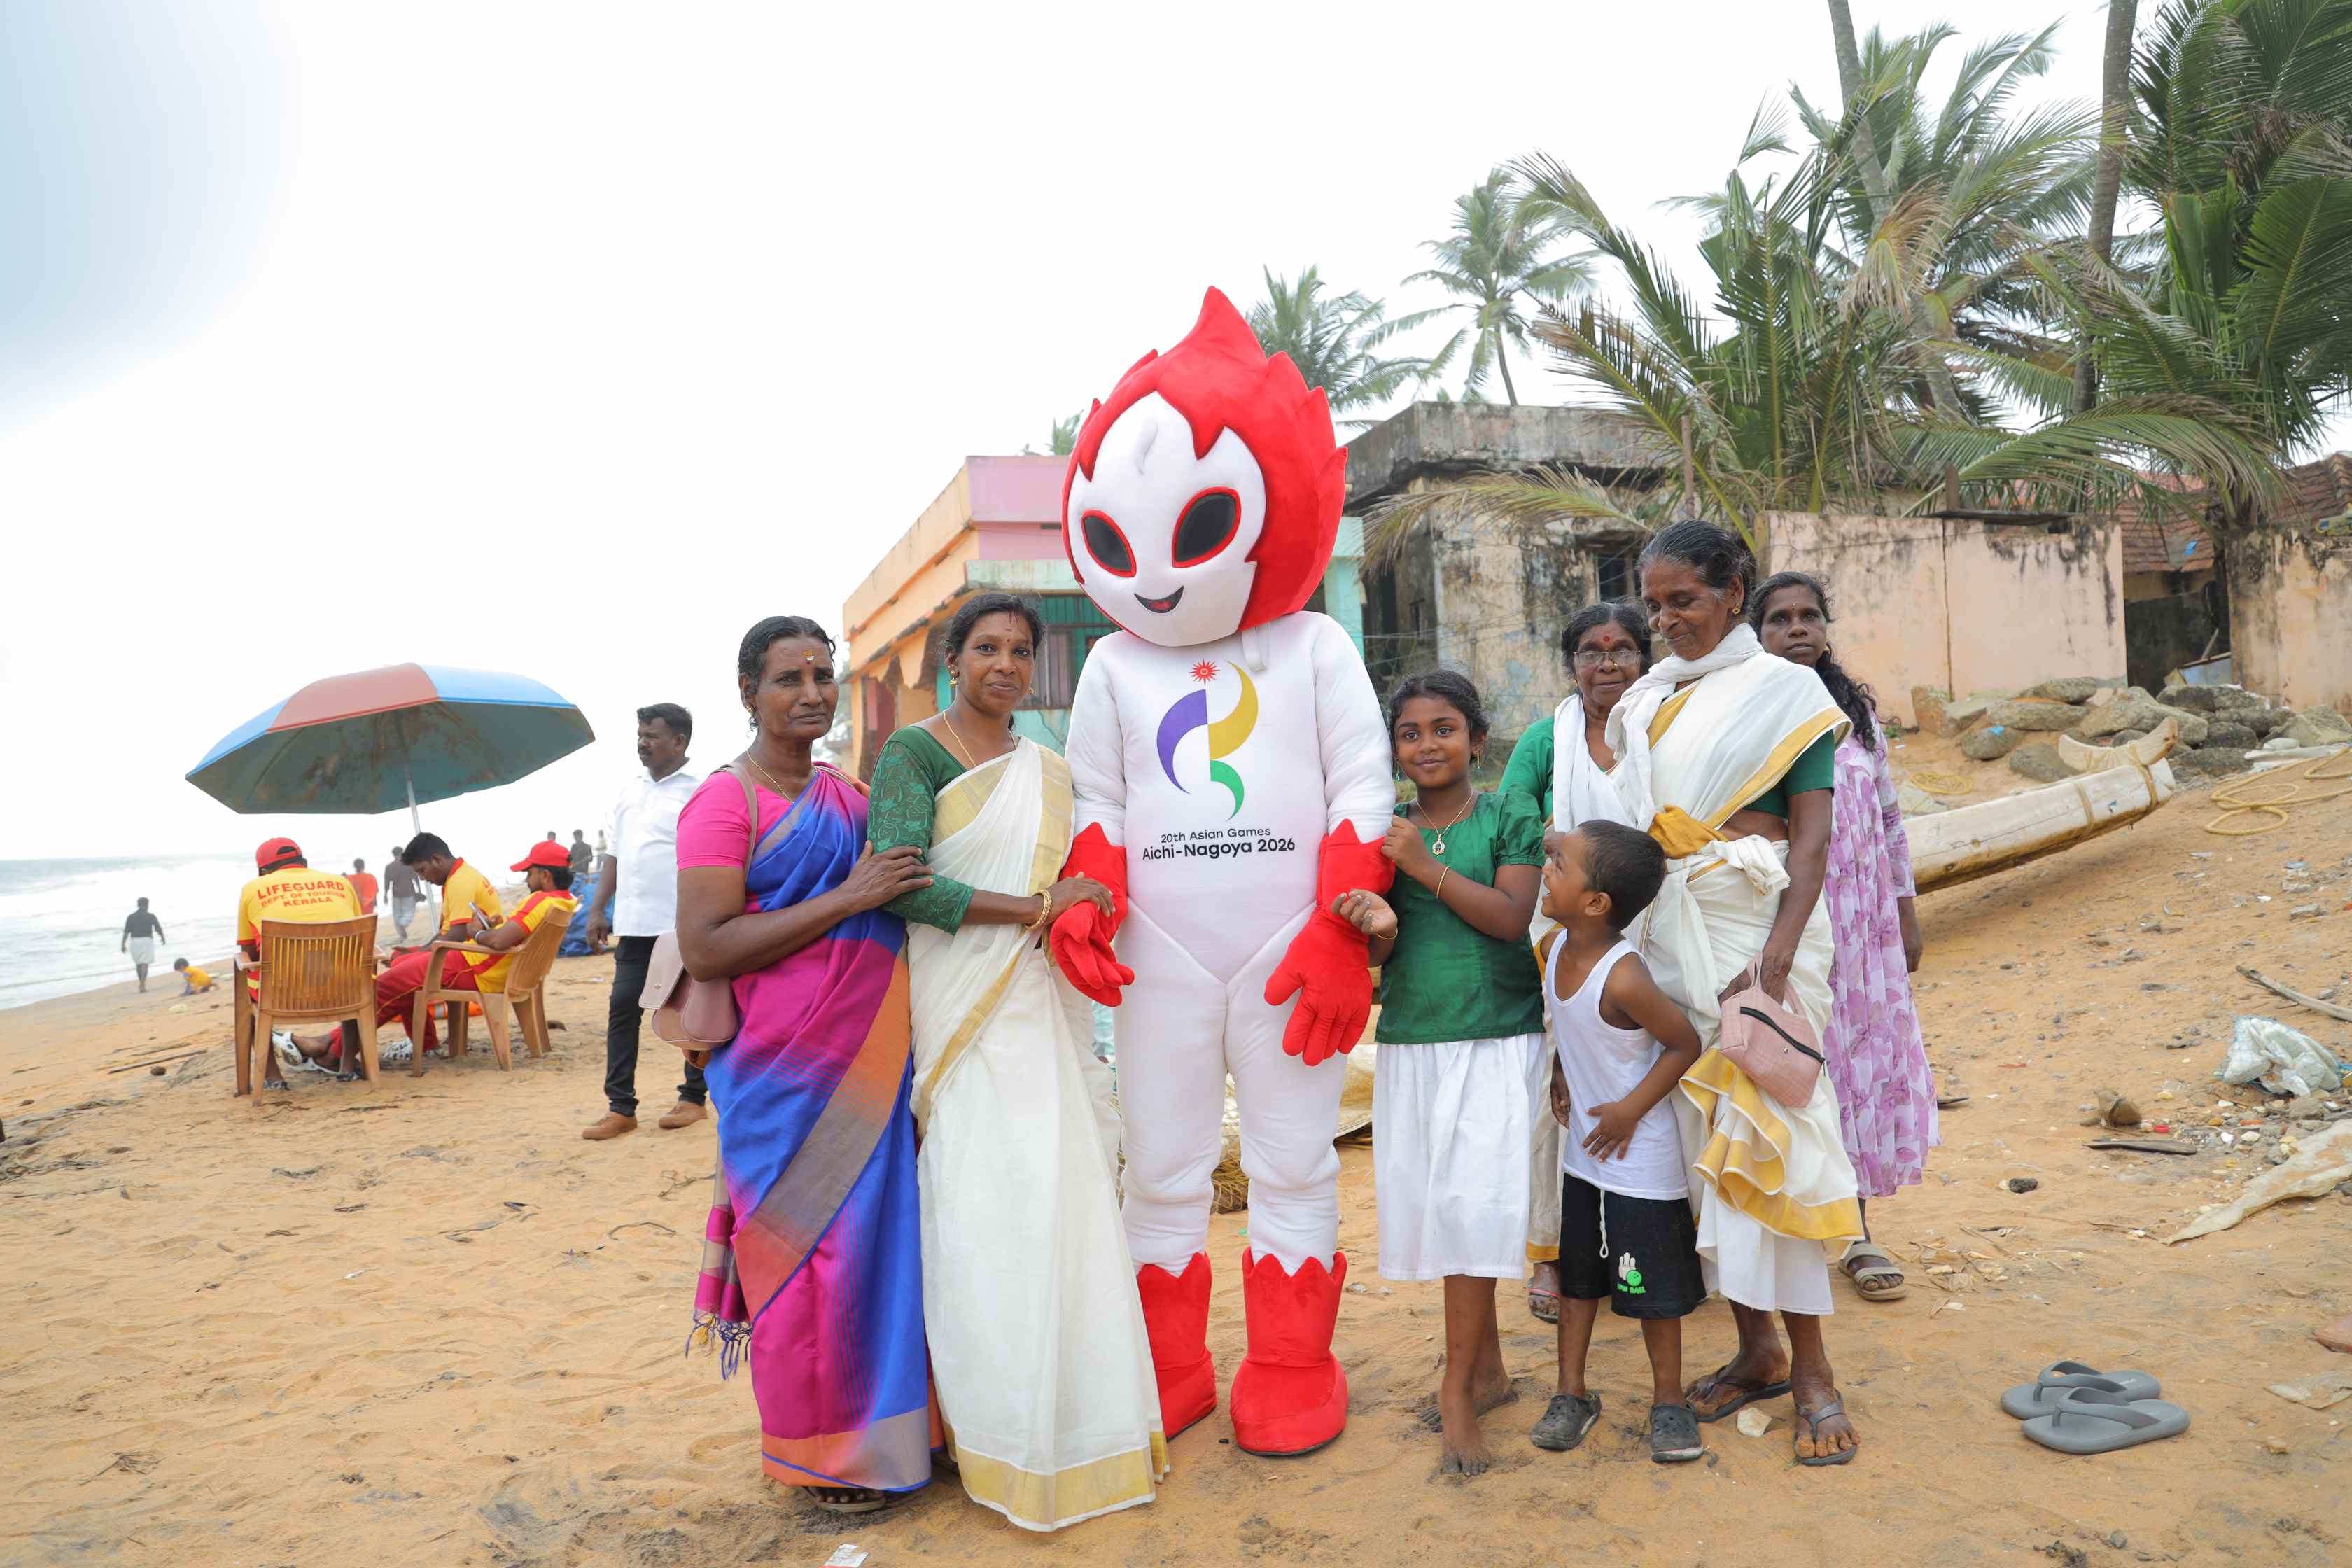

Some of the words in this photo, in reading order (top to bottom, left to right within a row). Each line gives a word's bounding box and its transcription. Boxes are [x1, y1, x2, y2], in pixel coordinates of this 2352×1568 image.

[1161, 832, 1186, 844] 20th
[1189, 829, 1224, 841] Asian
[1227, 827, 1271, 838] Games
[1142, 841, 1252, 860] Aichi-Nagoya
[1257, 837, 1296, 853] 2026
[257, 880, 345, 900] LIFEGUARD
[261, 894, 288, 908] DEPT.
[283, 897, 334, 907] KERALA
